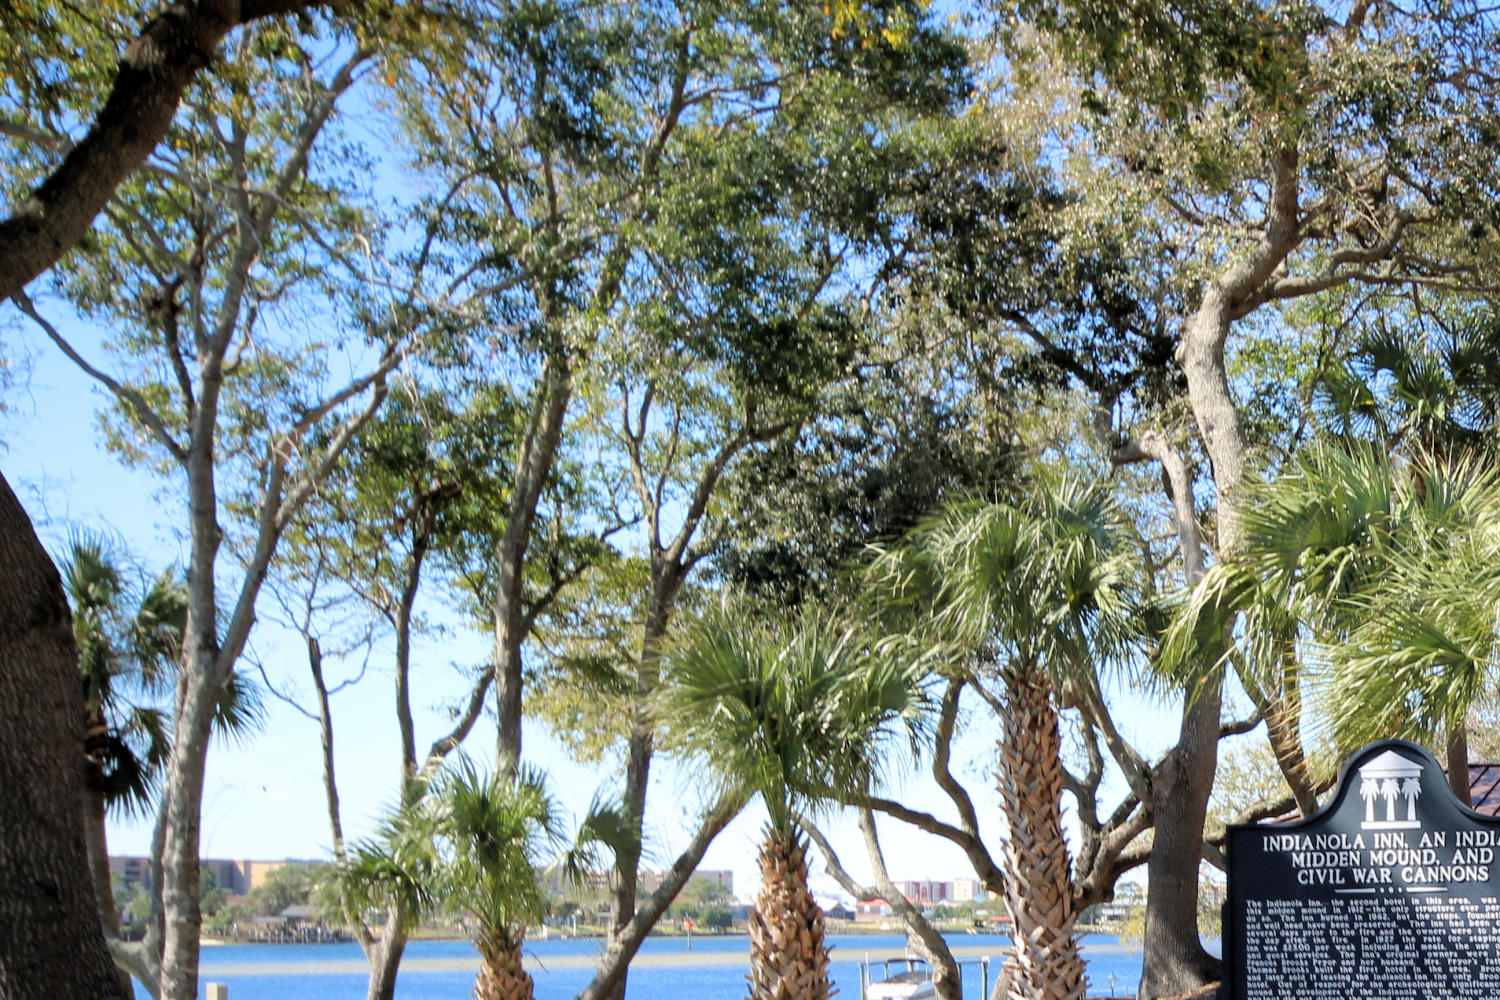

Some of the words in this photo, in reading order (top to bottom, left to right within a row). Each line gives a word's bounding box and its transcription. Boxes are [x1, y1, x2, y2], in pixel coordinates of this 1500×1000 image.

[1263, 833, 1365, 852] INDIANOLA
[1419, 831, 1446, 849] AN
[1291, 851, 1361, 868] MIDDEN
[1369, 849, 1440, 867] MOUND,
[1451, 848, 1494, 865] AND
[1297, 868, 1345, 885] CIVIL
[1353, 867, 1393, 884] WAR
[1401, 866, 1489, 883] CANNONS
[1391, 906, 1409, 914] only
[1280, 930, 1298, 938] days
[1303, 929, 1324, 938] prior
[1265, 937, 1279, 945] day
[1361, 944, 1399, 952] including
[1386, 951, 1419, 959] original
[1321, 974, 1351, 982] leaving
[1453, 973, 1471, 982] only
[1314, 981, 1345, 990] respect
[1388, 981, 1446, 989] archeological
[1296, 989, 1340, 997] developers
